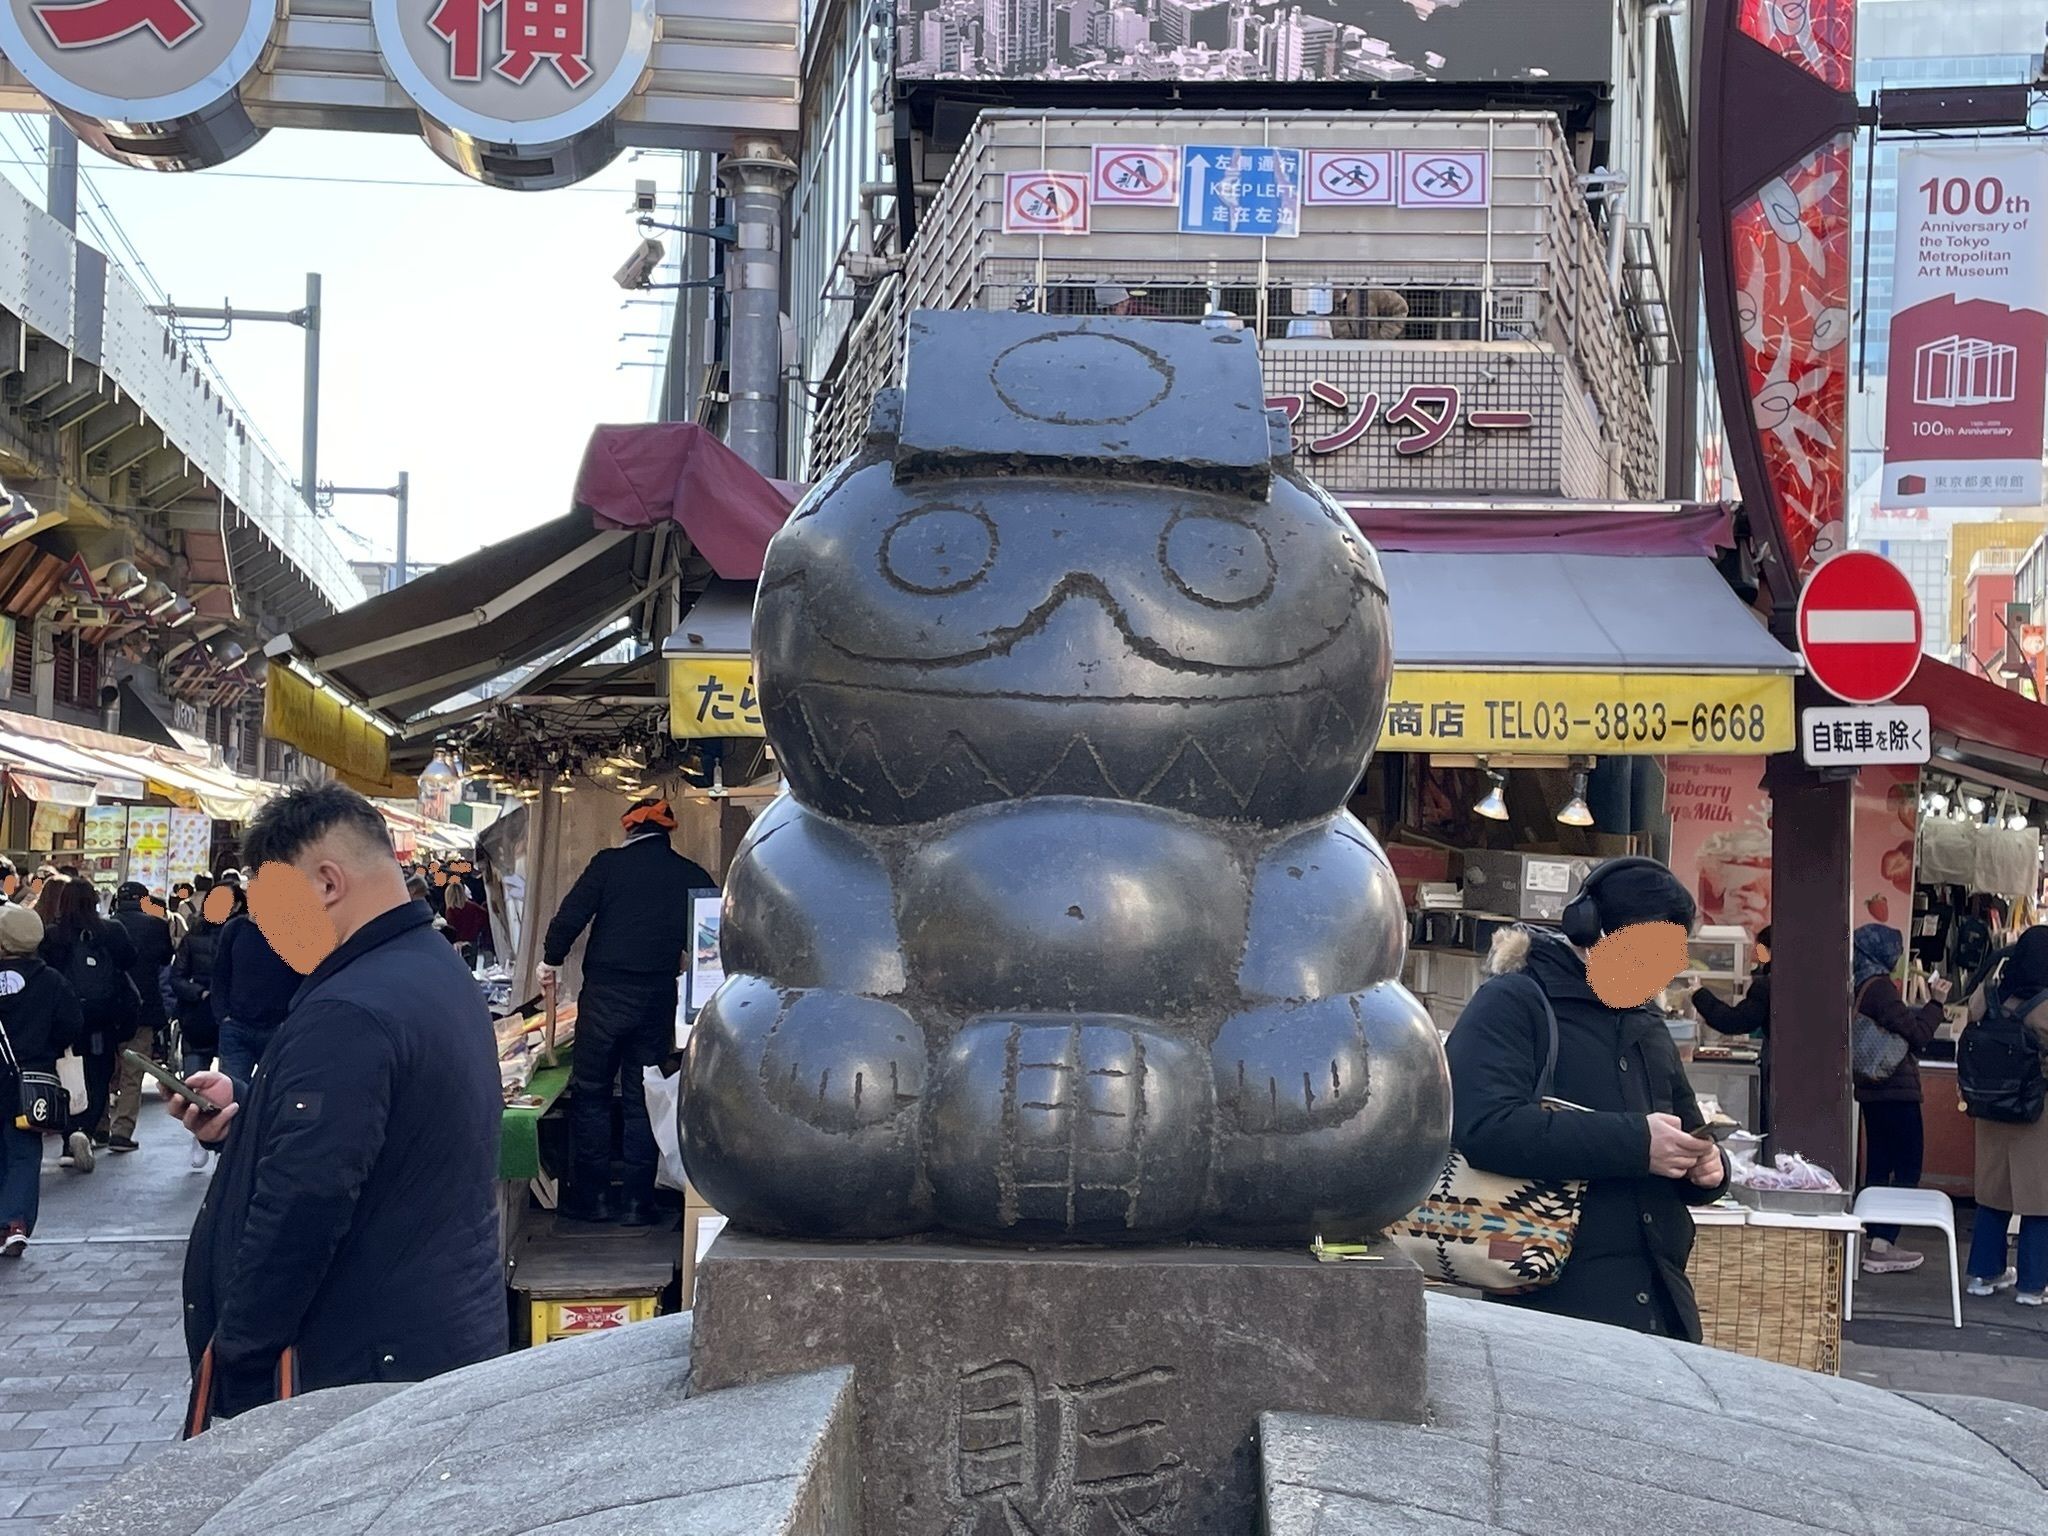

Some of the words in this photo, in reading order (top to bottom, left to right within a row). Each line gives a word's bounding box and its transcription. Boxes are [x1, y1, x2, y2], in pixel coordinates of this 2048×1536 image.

[1214, 155, 1296, 173] 左側通行
[1209, 182, 1253, 197] KEEP
[1256, 184, 1297, 198] LEFT
[1919, 176, 2030, 216] 100th
[1212, 206, 1293, 224] 走在左边
[1920, 220, 2010, 233] Anniversary
[2013, 218, 2029, 230] of
[1919, 236, 1943, 247] the
[1946, 235, 1990, 249] Tokyo
[1918, 250, 2012, 264] Metropolitan
[1917, 265, 1941, 277] Art
[1945, 265, 2009, 277] Museum
[1912, 421, 1954, 437] 100th
[1958, 426, 2013, 436] Anniversary
[1934, 475, 2024, 488] 東京都美術館
[1812, 719, 1923, 753] 自転車を除く
[1694, 802, 1733, 822] Milk
